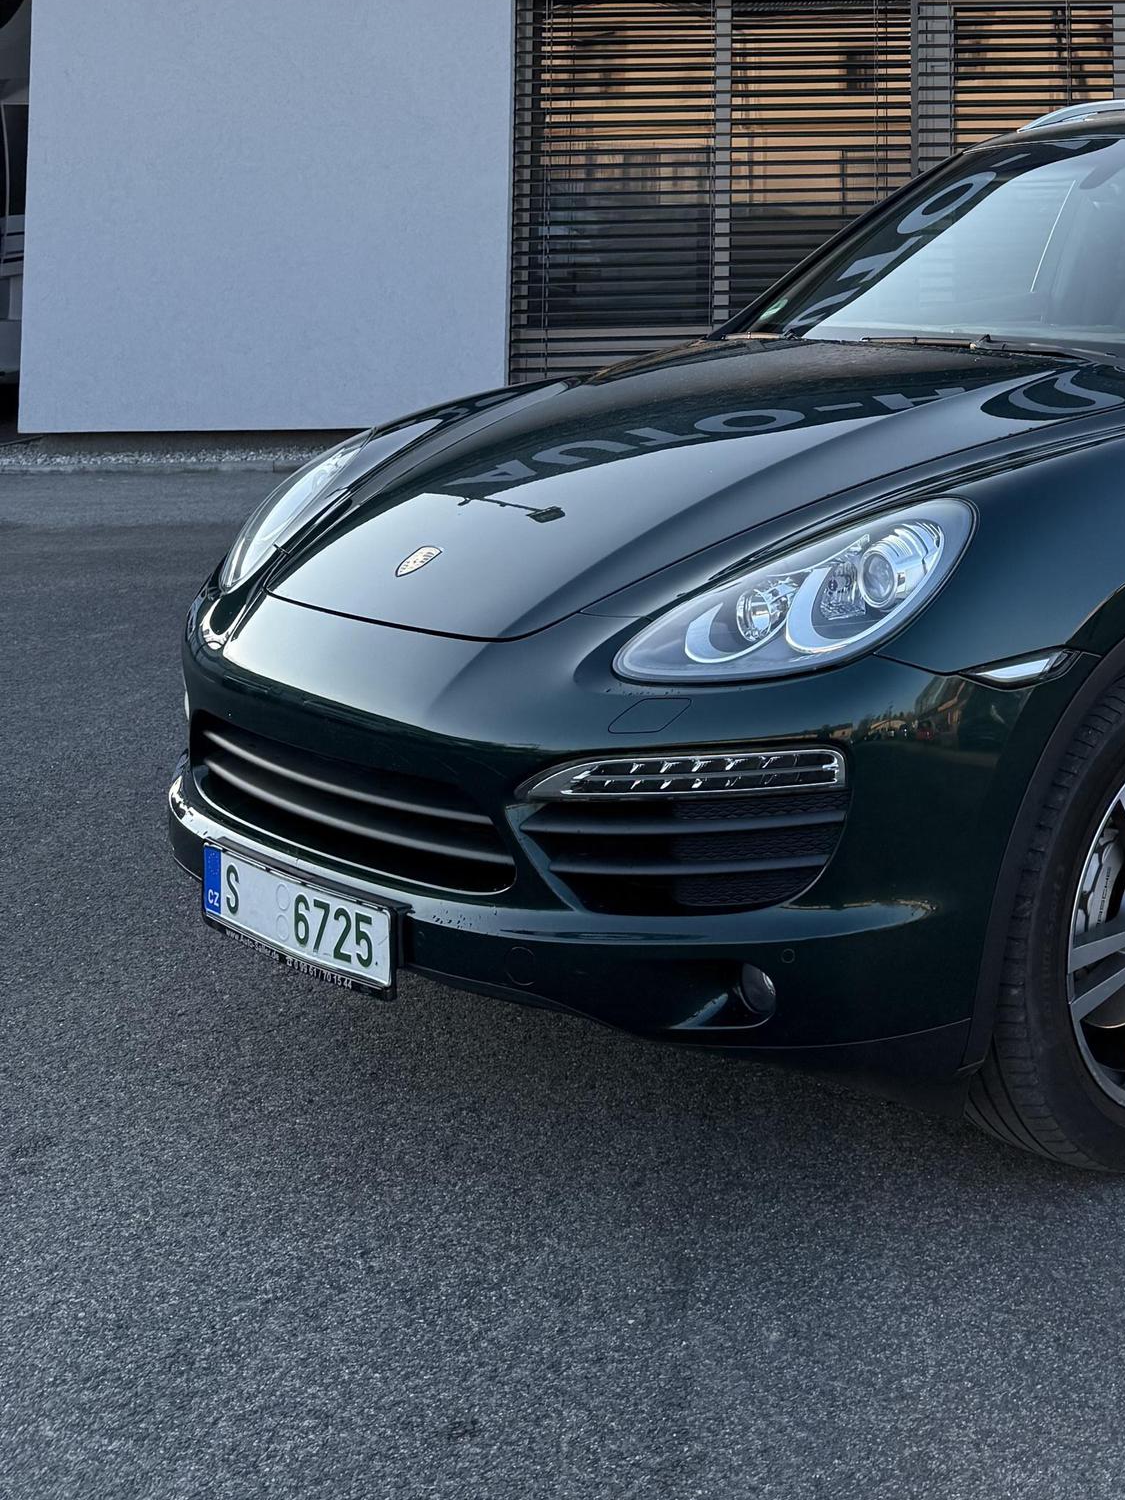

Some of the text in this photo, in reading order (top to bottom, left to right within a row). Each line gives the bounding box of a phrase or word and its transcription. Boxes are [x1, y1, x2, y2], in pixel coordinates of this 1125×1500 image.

[207, 888, 220, 908] CZ
[226, 864, 374, 968] S 6725
